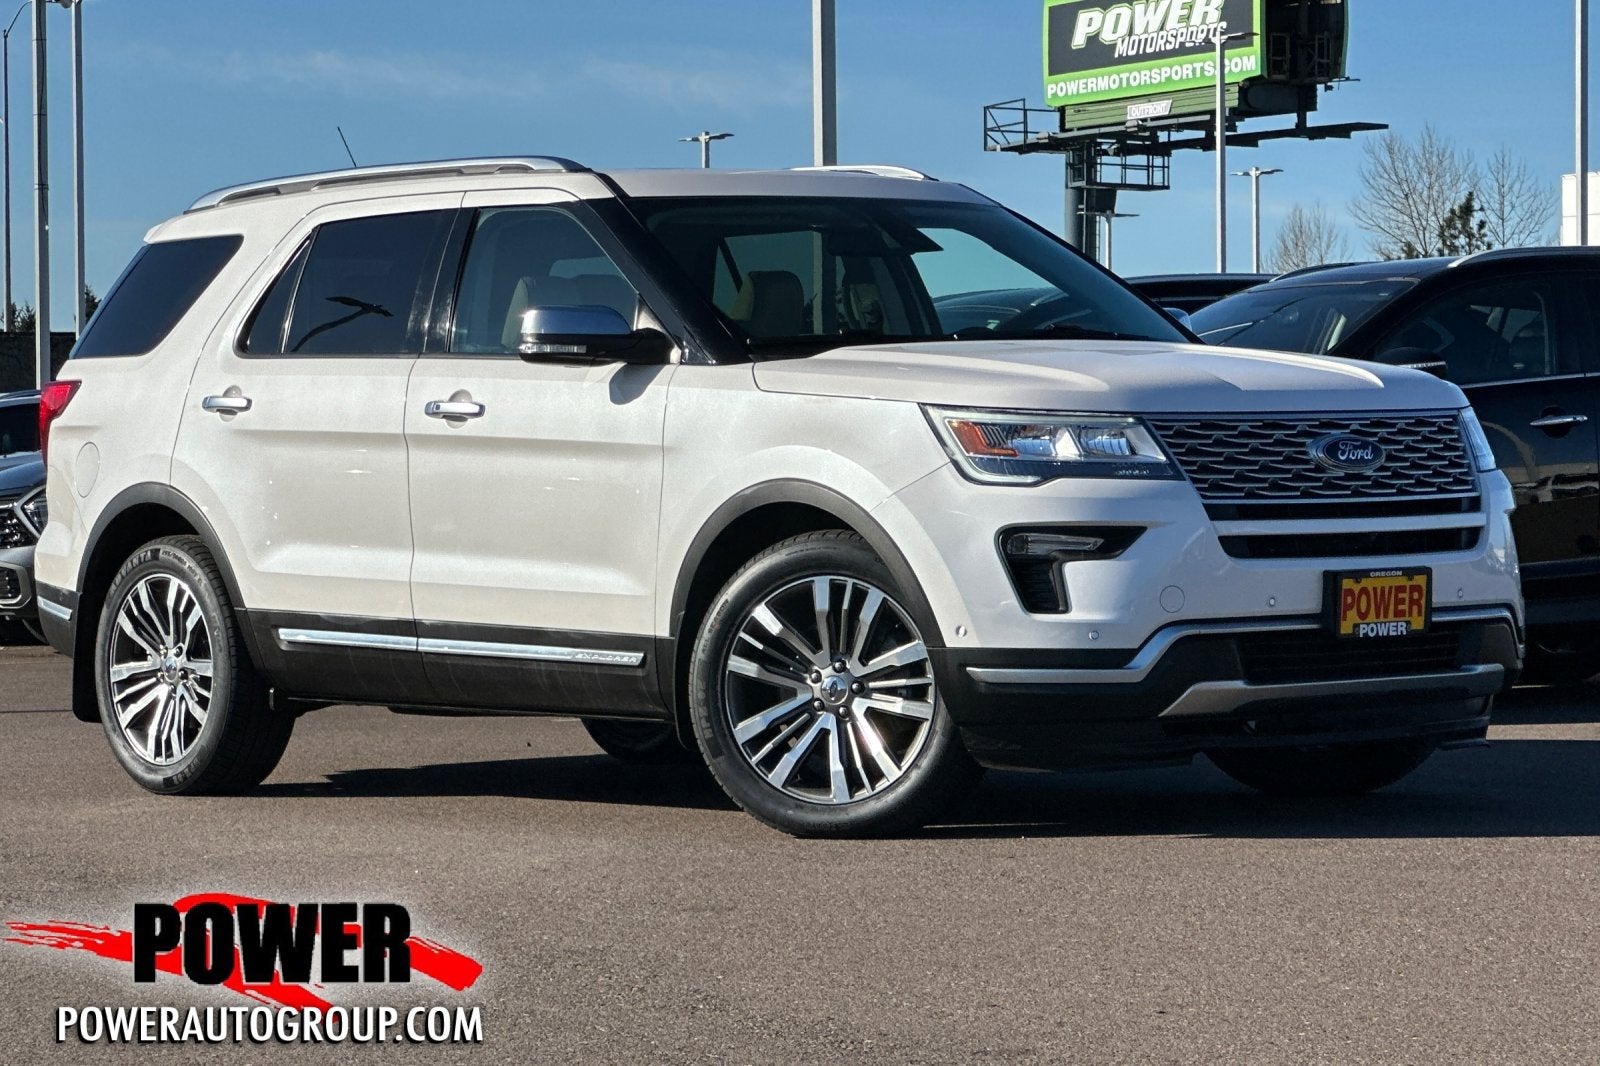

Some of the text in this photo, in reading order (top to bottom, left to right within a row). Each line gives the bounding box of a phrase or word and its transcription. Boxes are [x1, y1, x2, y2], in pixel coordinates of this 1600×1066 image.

[1071, 0, 1224, 49] POWER
[1338, 440, 1374, 460] Ford
[1369, 570, 1403, 578] OREGON
[1341, 584, 1424, 622] POWER
[1359, 621, 1407, 638] POWER
